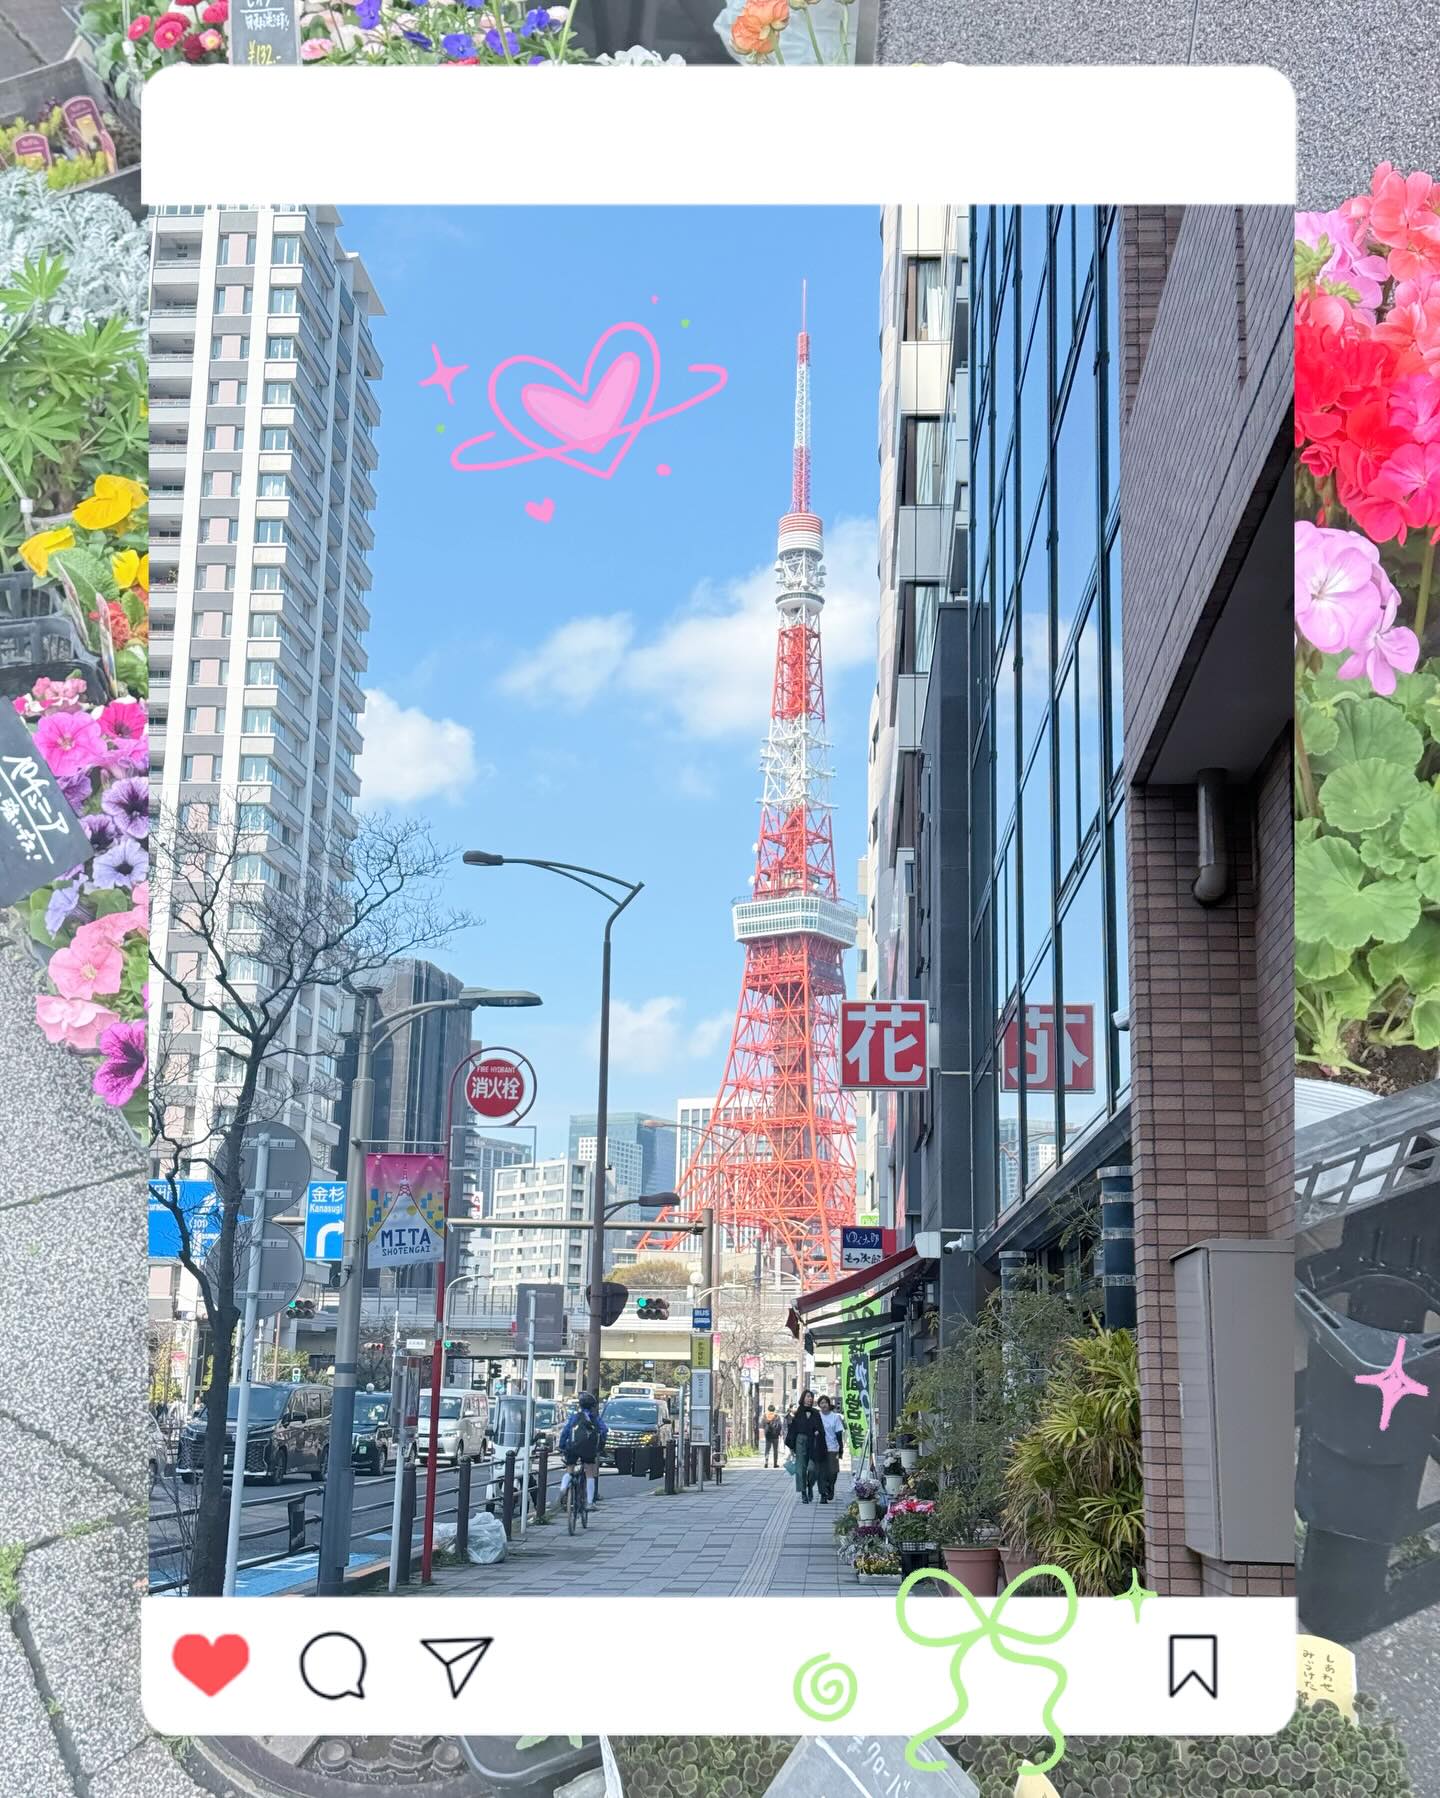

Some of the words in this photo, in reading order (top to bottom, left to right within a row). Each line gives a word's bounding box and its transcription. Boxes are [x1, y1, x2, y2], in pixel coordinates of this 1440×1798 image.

[845, 1004, 923, 1083] 花
[471, 1076, 521, 1100] 消火栓
[312, 1186, 345, 1203] 金杉
[309, 1203, 343, 1215] Kanasugi
[381, 1228, 431, 1248] MITA
[382, 1246, 431, 1257] SHOTENGAI
[694, 1309, 710, 1317] BUS
[1320, 1654, 1335, 1693] しあわせ
